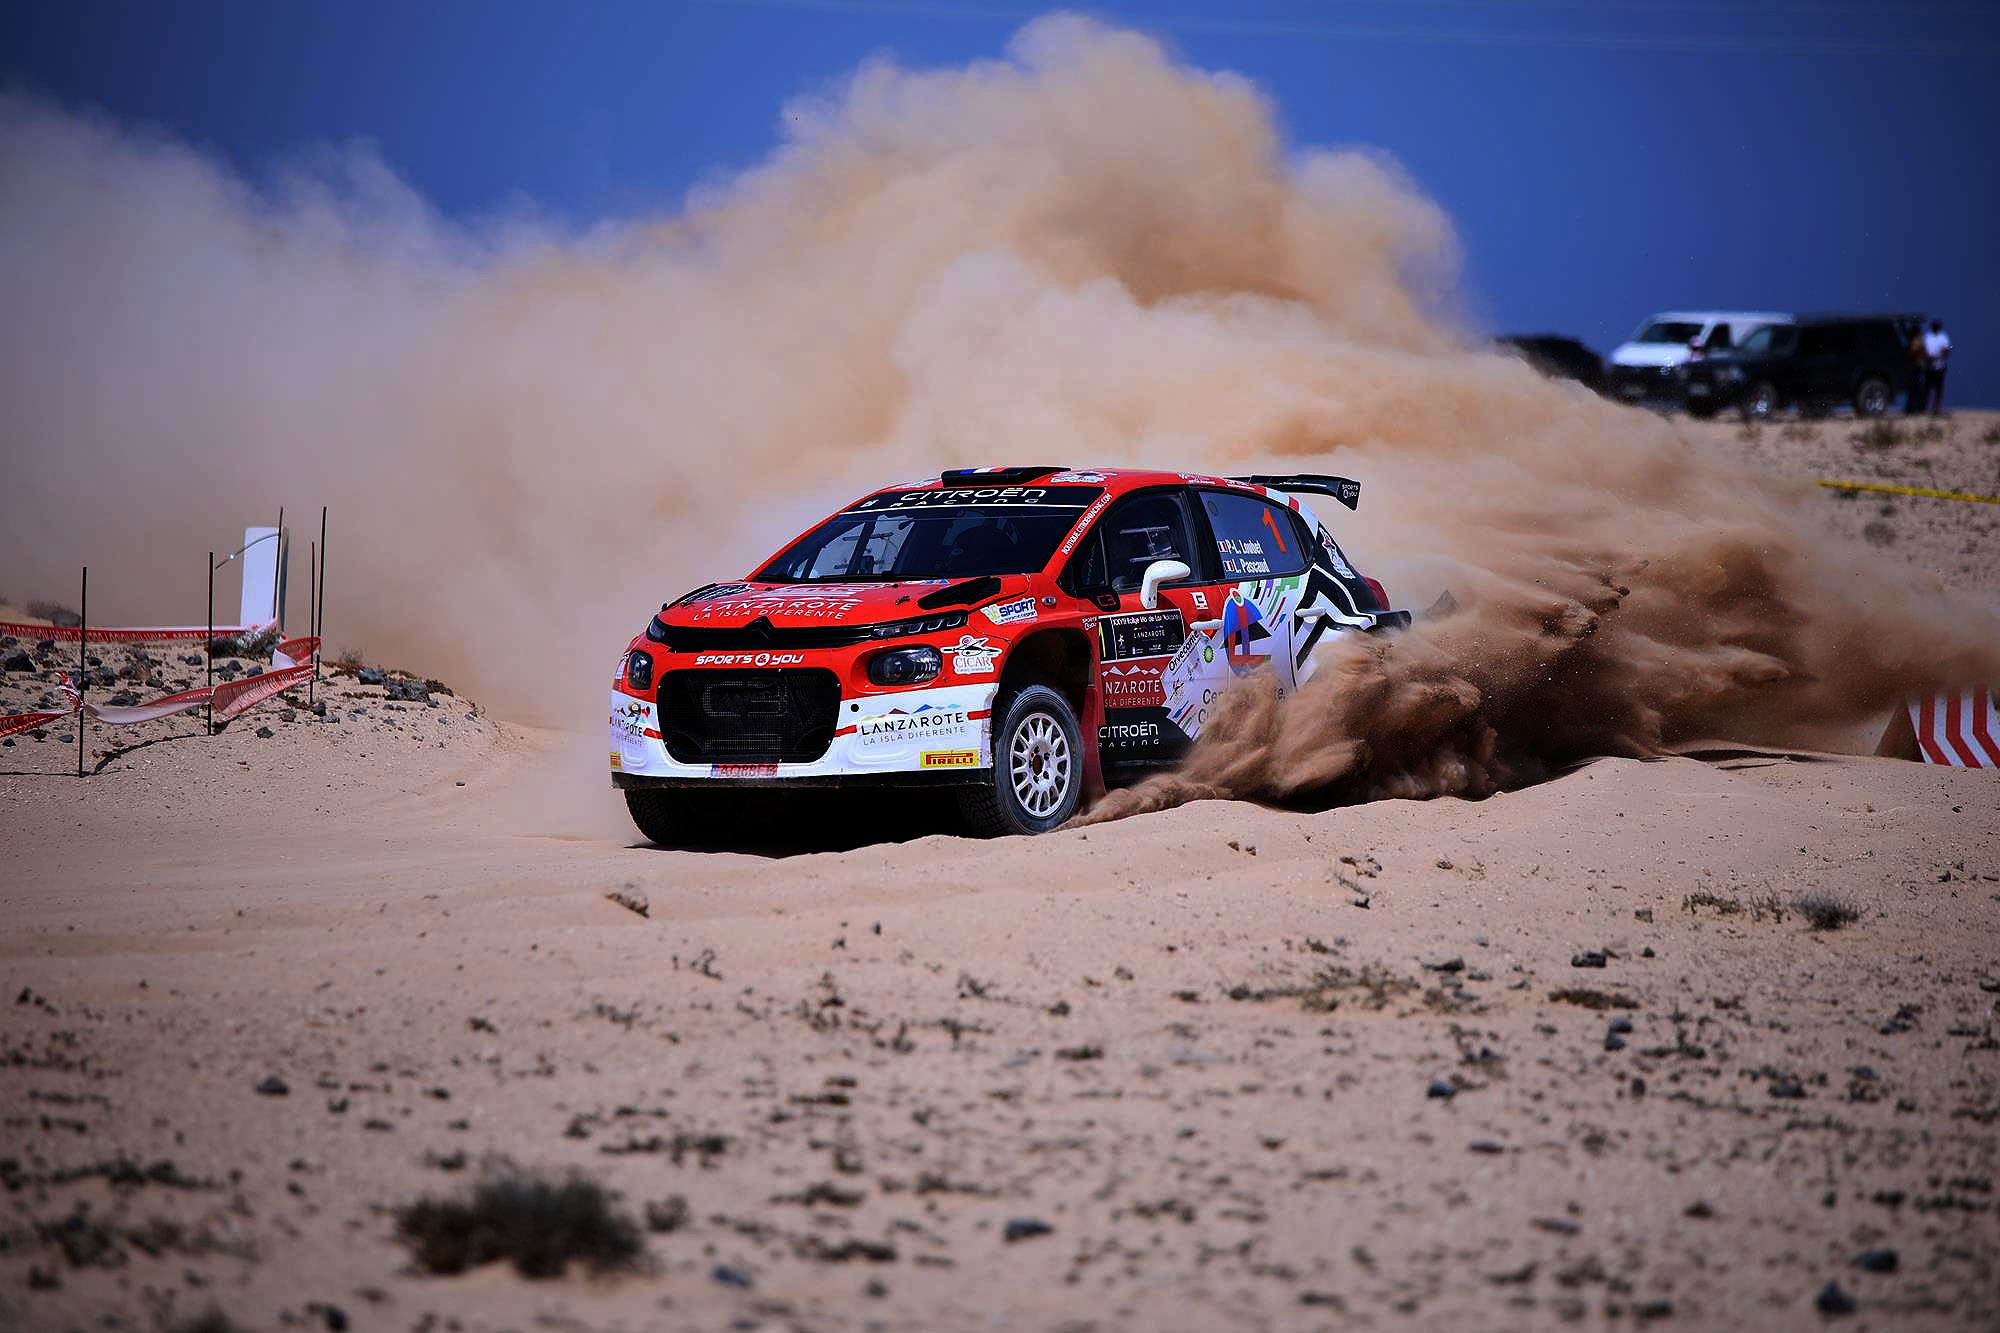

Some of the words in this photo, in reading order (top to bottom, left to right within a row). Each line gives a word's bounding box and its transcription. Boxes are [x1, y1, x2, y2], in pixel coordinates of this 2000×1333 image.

[890, 498, 1038, 508] RACING
[1262, 507, 1287, 554] 1
[702, 601, 858, 612] LANZAROTE
[999, 599, 1034, 617] SPORT
[758, 609, 847, 620] DIFERENTE
[1133, 630, 1165, 639] LANZAROTE
[695, 655, 752, 665] SPORTS
[770, 654, 805, 665] YOU
[955, 656, 991, 668] CICAR
[861, 712, 964, 736] LANZAROTE
[863, 737, 876, 746] LA
[880, 734, 903, 743] ISLA
[908, 726, 966, 740] DIFERENTE
[1097, 739, 1159, 748] RACING
[926, 752, 974, 765] PIRELLI
